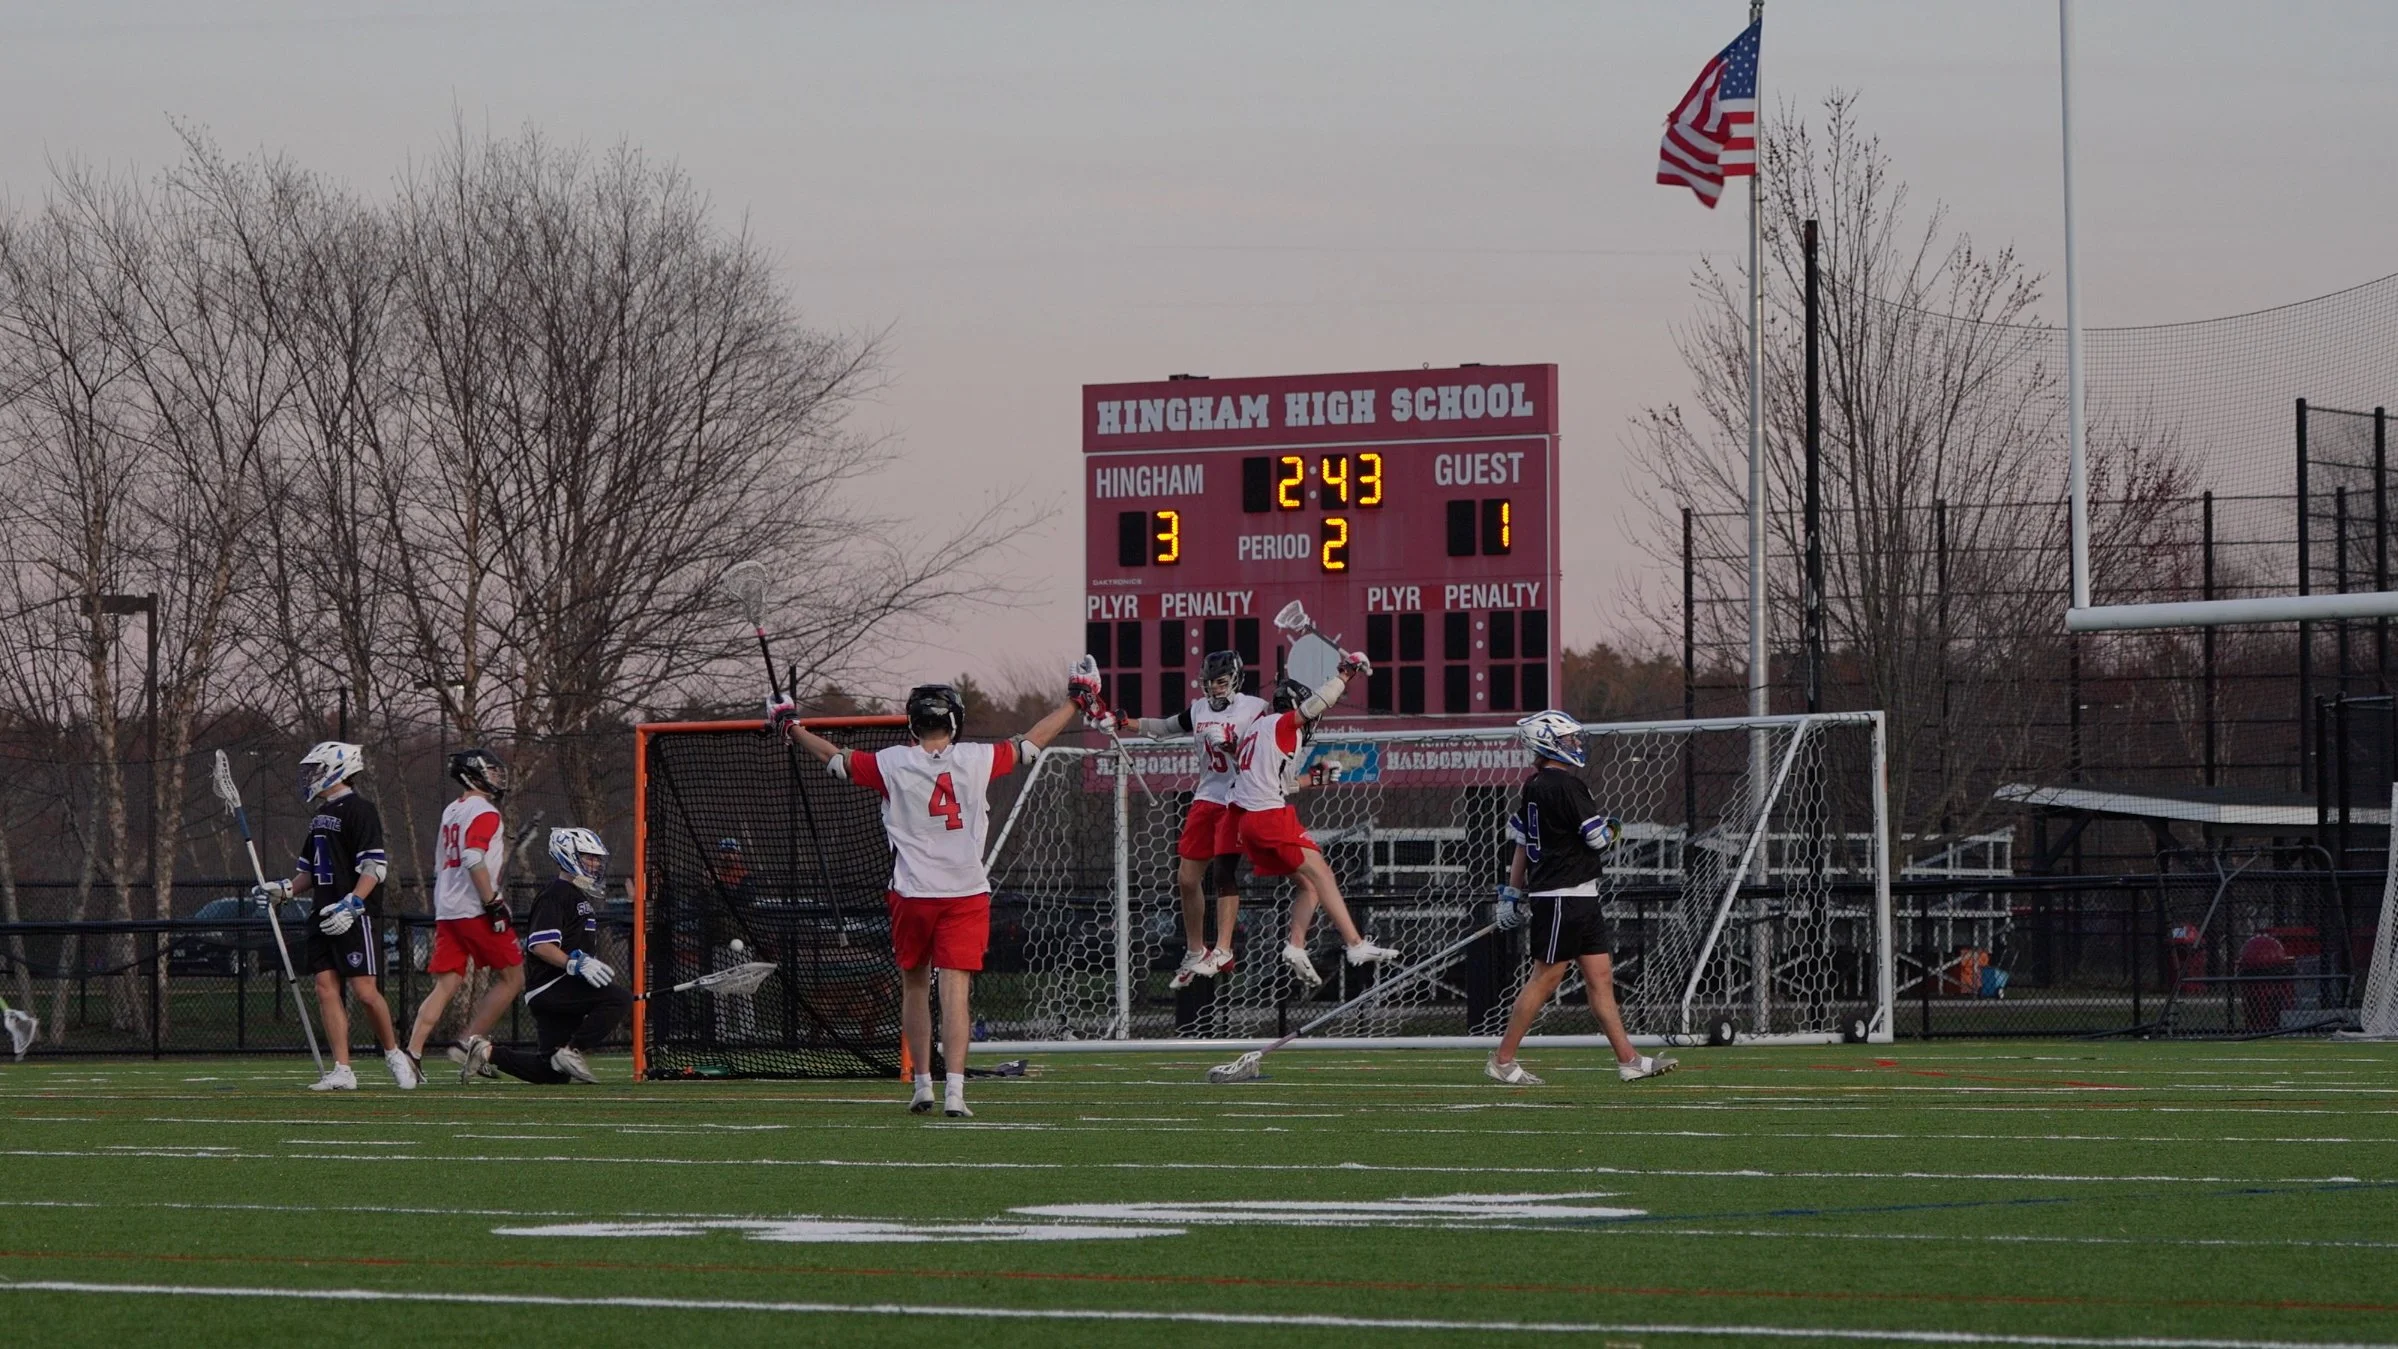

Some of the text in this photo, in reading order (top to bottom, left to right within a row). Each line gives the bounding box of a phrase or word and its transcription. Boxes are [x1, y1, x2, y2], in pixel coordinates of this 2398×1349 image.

[1096, 382, 1534, 435] HINGHAM HIGH SCHOOL
[1095, 464, 1204, 499] HINGHAM
[1278, 452, 1383, 507] 2:43
[1434, 452, 1525, 486] GUEST
[1156, 510, 1180, 562] 3
[1238, 533, 1311, 561] PERIOD
[1322, 517, 1349, 569] 2
[1092, 578, 1143, 586] DAKTRONICS
[1367, 582, 1541, 612] PLYR PENALTY
[1087, 590, 1253, 619] PLYR PENALTY
[928, 771, 964, 831] 4
[312, 834, 334, 885] 4
